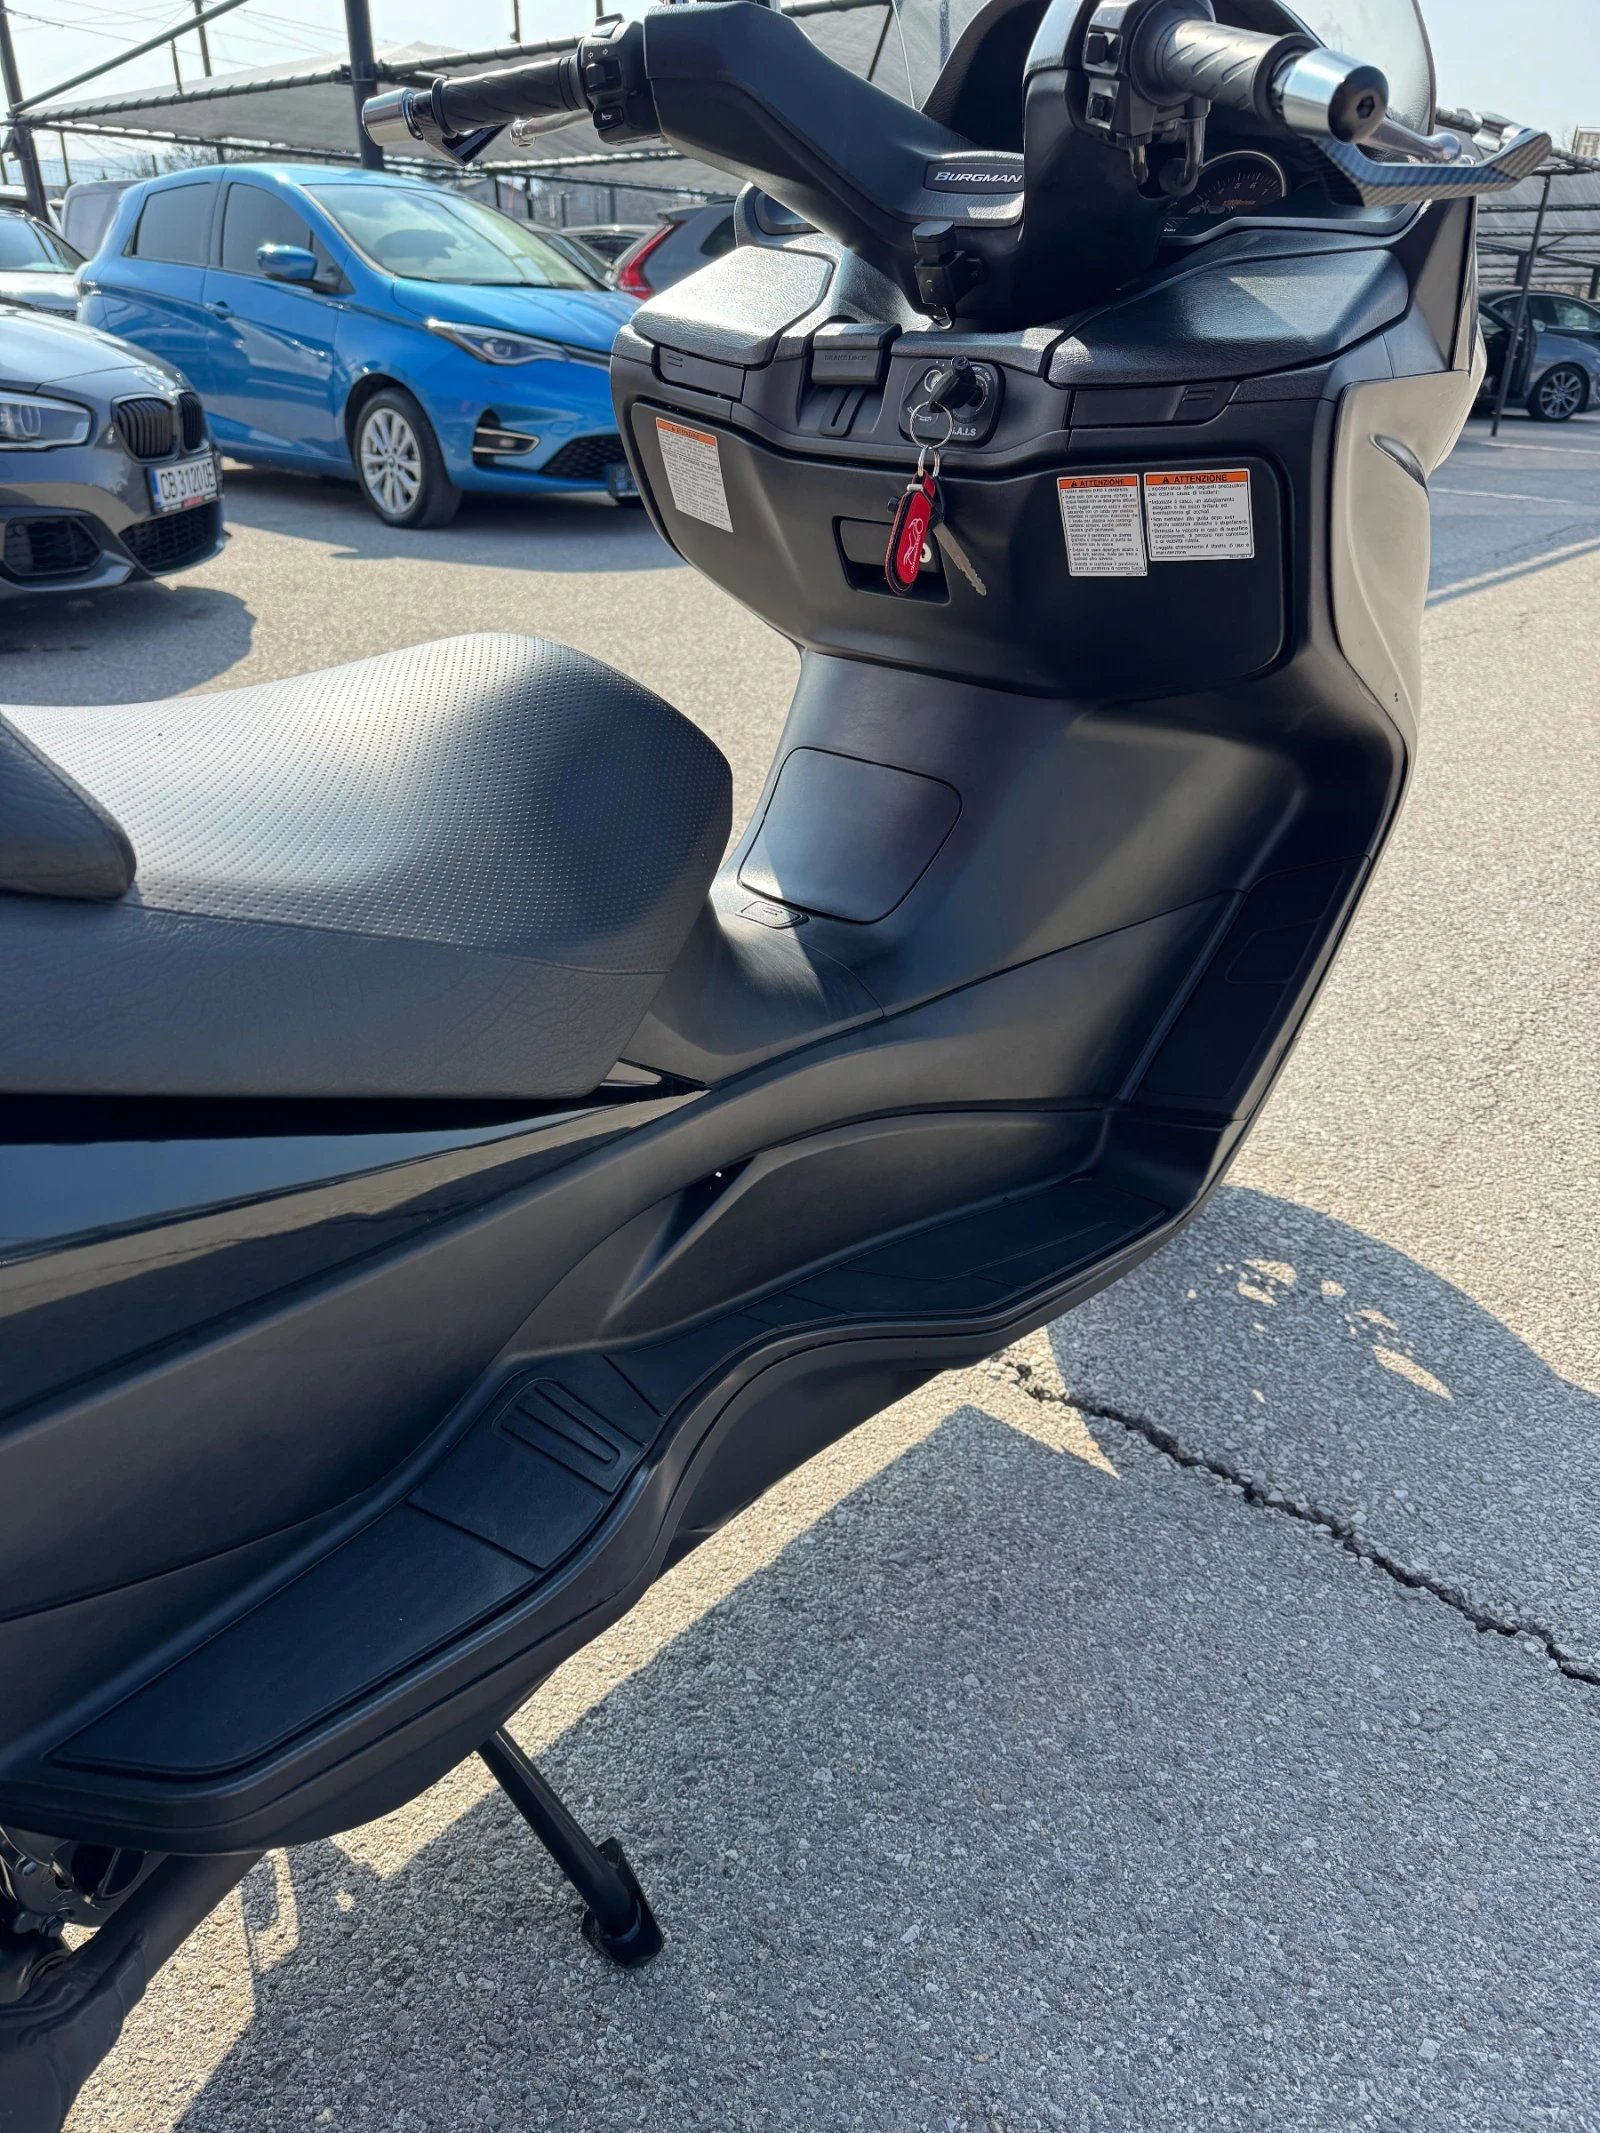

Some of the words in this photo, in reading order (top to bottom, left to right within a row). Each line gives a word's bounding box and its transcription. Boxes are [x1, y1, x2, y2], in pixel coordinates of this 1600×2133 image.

[934, 171, 1023, 183] BURGMAN
[1080, 479, 1125, 487] ATTENZIONE
[1174, 474, 1228, 483] ATTENZIONE
